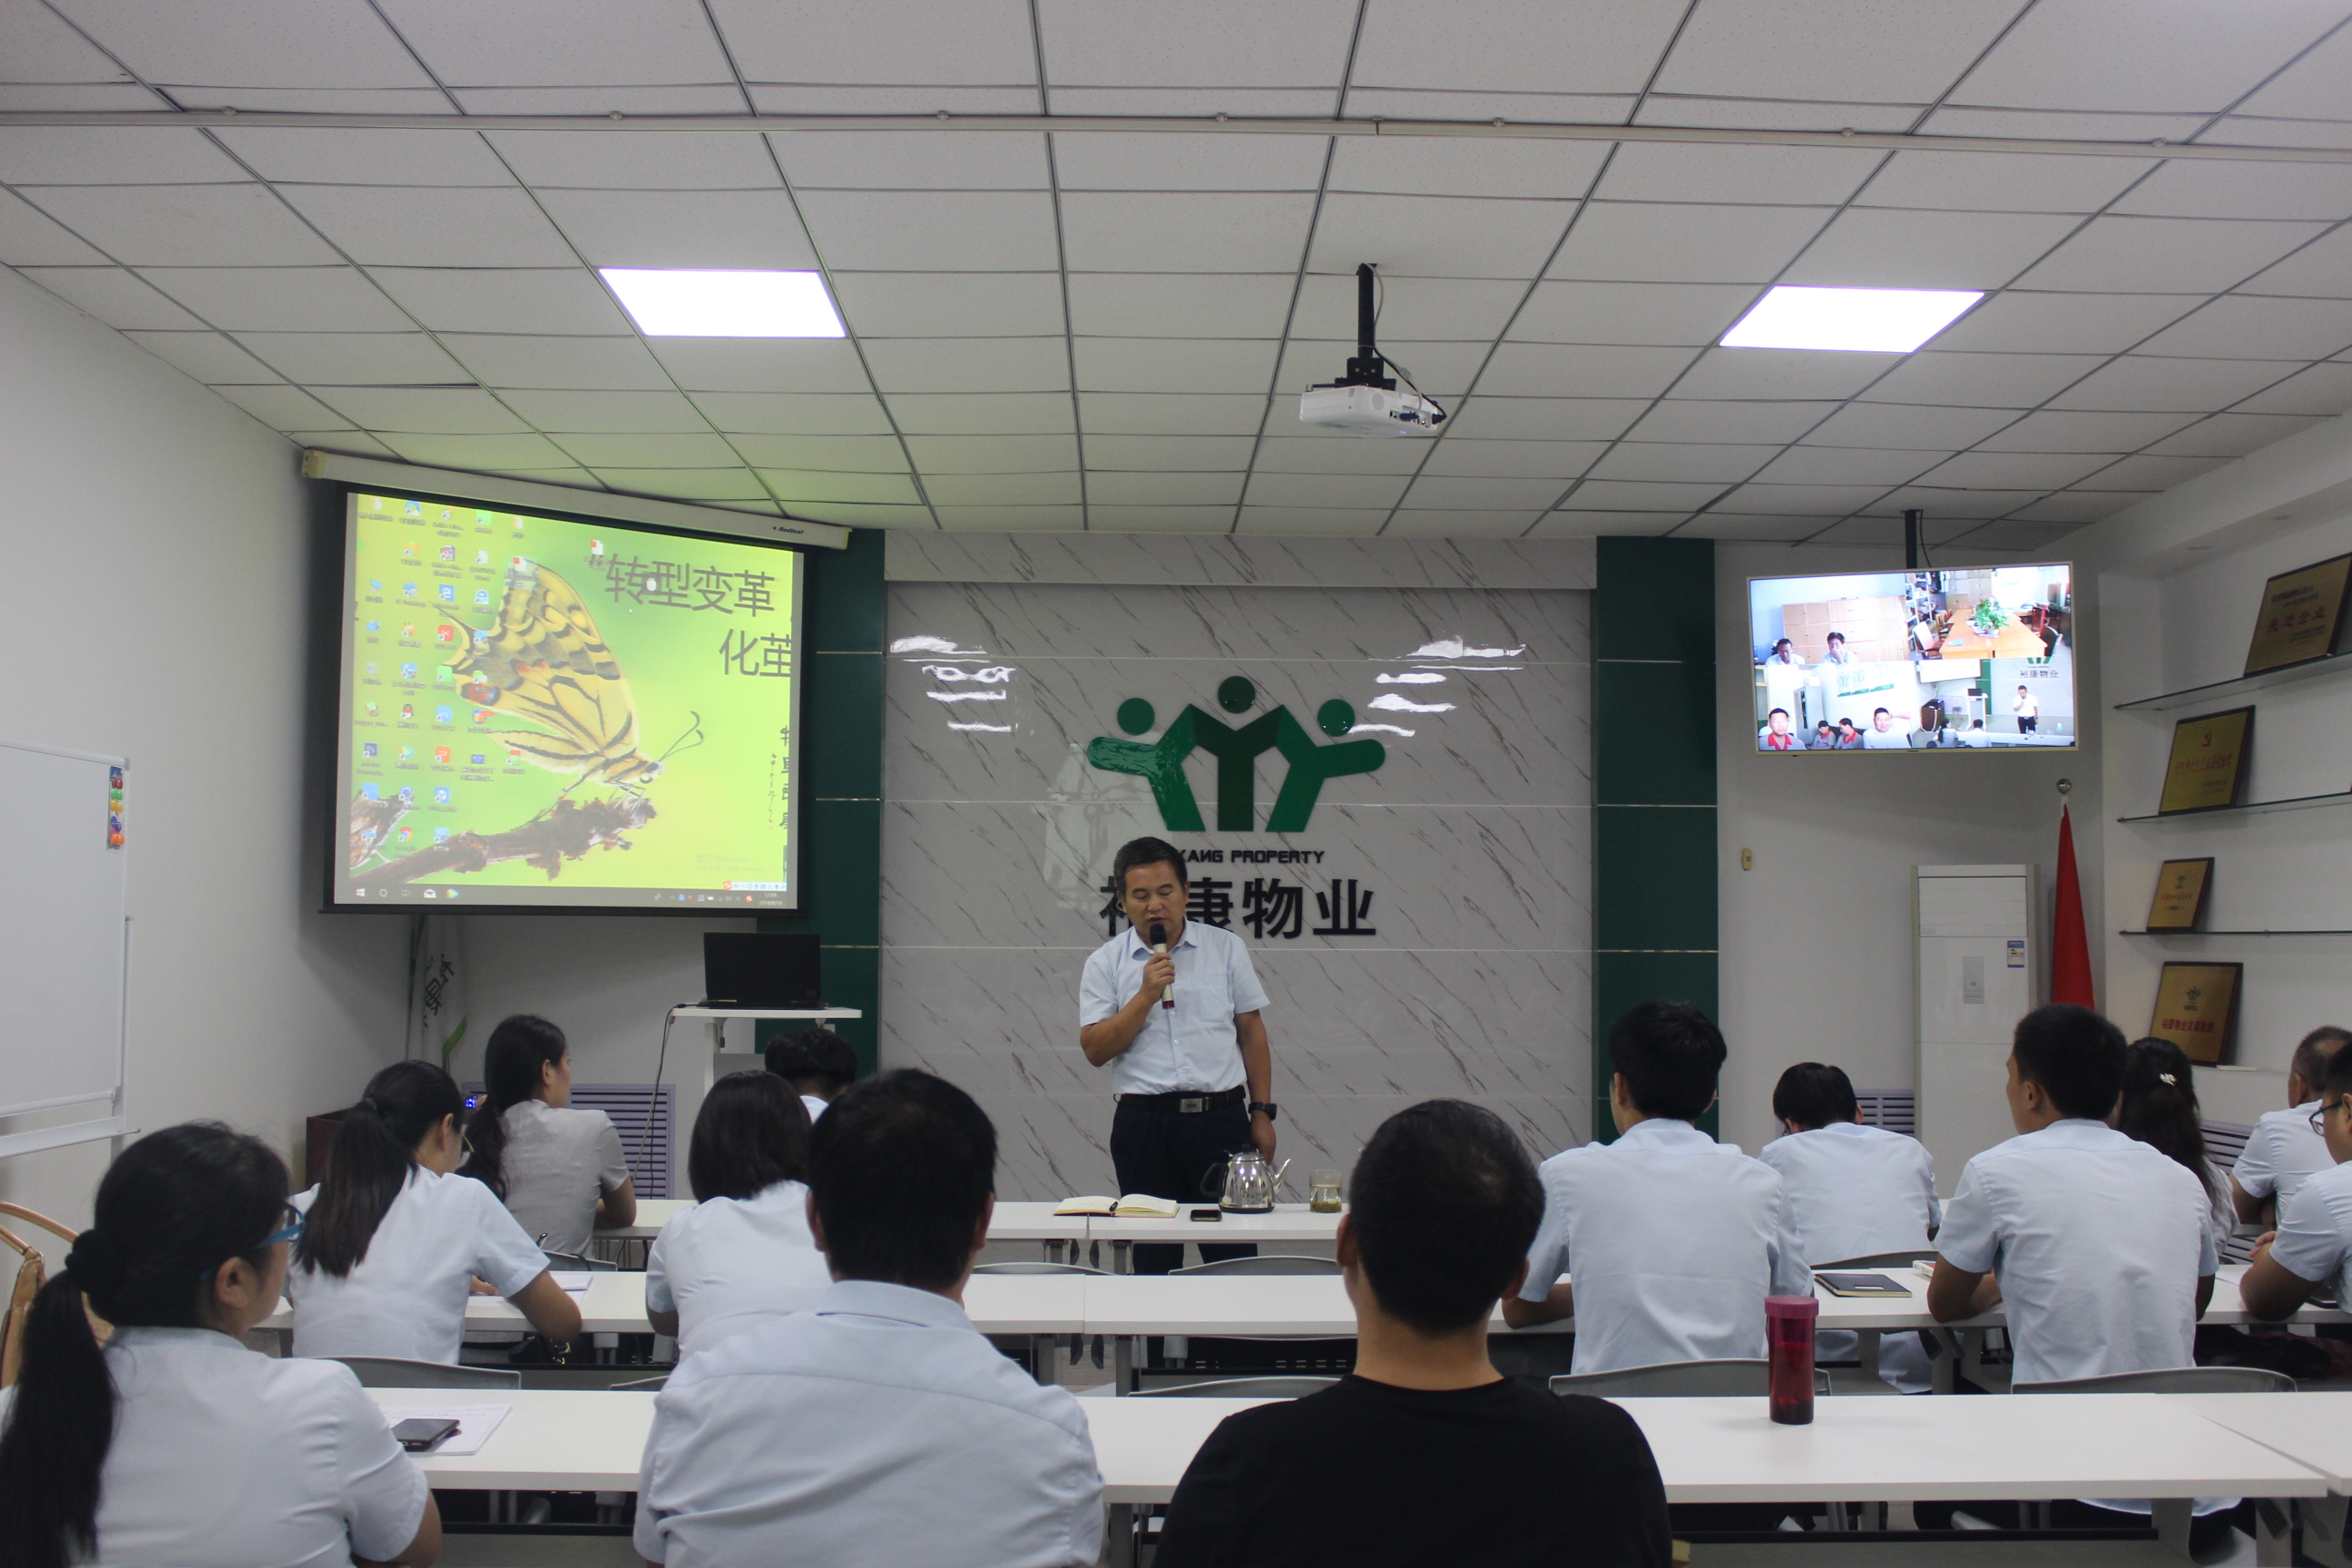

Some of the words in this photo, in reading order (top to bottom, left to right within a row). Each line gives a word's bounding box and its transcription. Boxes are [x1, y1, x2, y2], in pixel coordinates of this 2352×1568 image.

[779, 526, 805, 534] Redleaf
[1230, 849, 1325, 864] PROPERTY
[1100, 876, 1377, 938] 康物业
